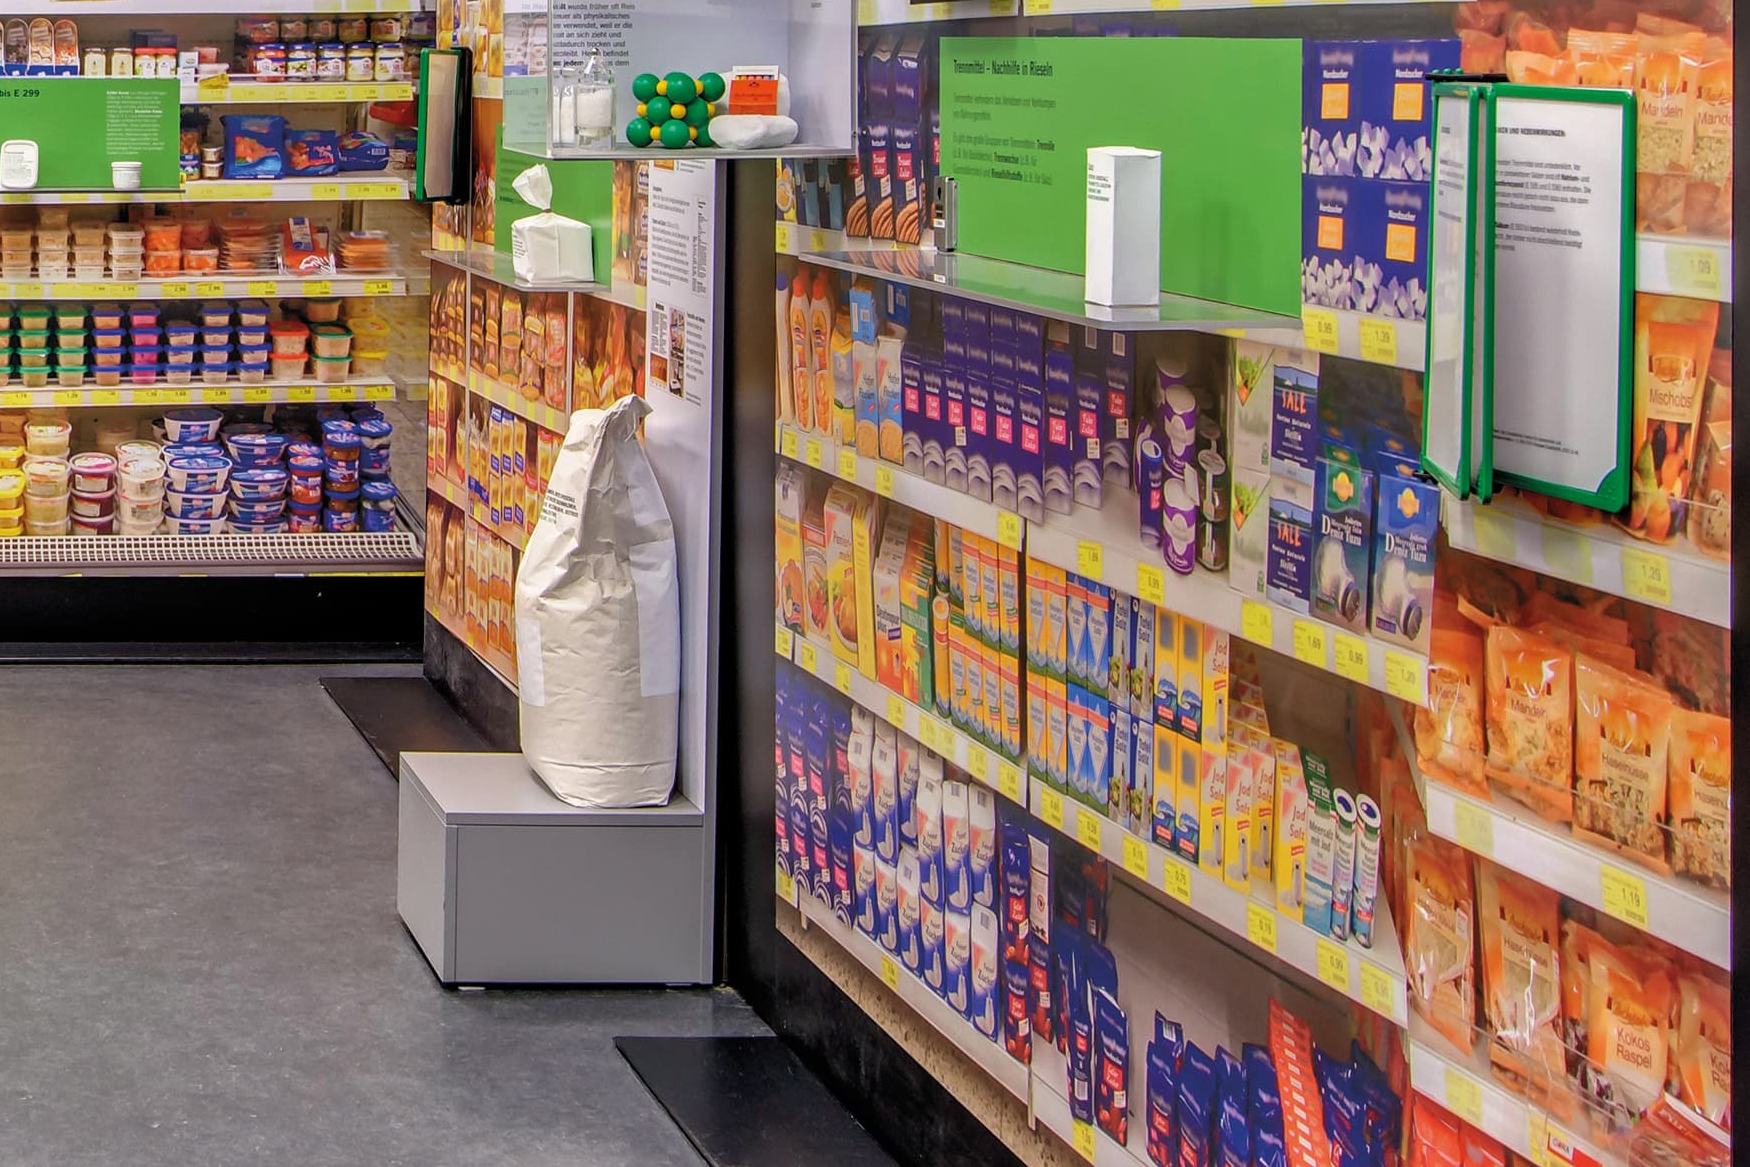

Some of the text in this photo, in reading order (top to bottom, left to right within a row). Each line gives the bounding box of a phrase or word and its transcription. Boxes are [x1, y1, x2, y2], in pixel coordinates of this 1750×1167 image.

[954, 59, 1053, 76] Trennmittel Nachhilfe in Rieseln
[0, 89, 11, 97] bis
[1282, 390, 1307, 414] SALE
[1277, 522, 1301, 547] SALE
[1215, 639, 1228, 655] Jod
[1259, 768, 1274, 784] Jod
[1291, 804, 1306, 821] Jod
[1616, 1028, 1651, 1051] Kokos
